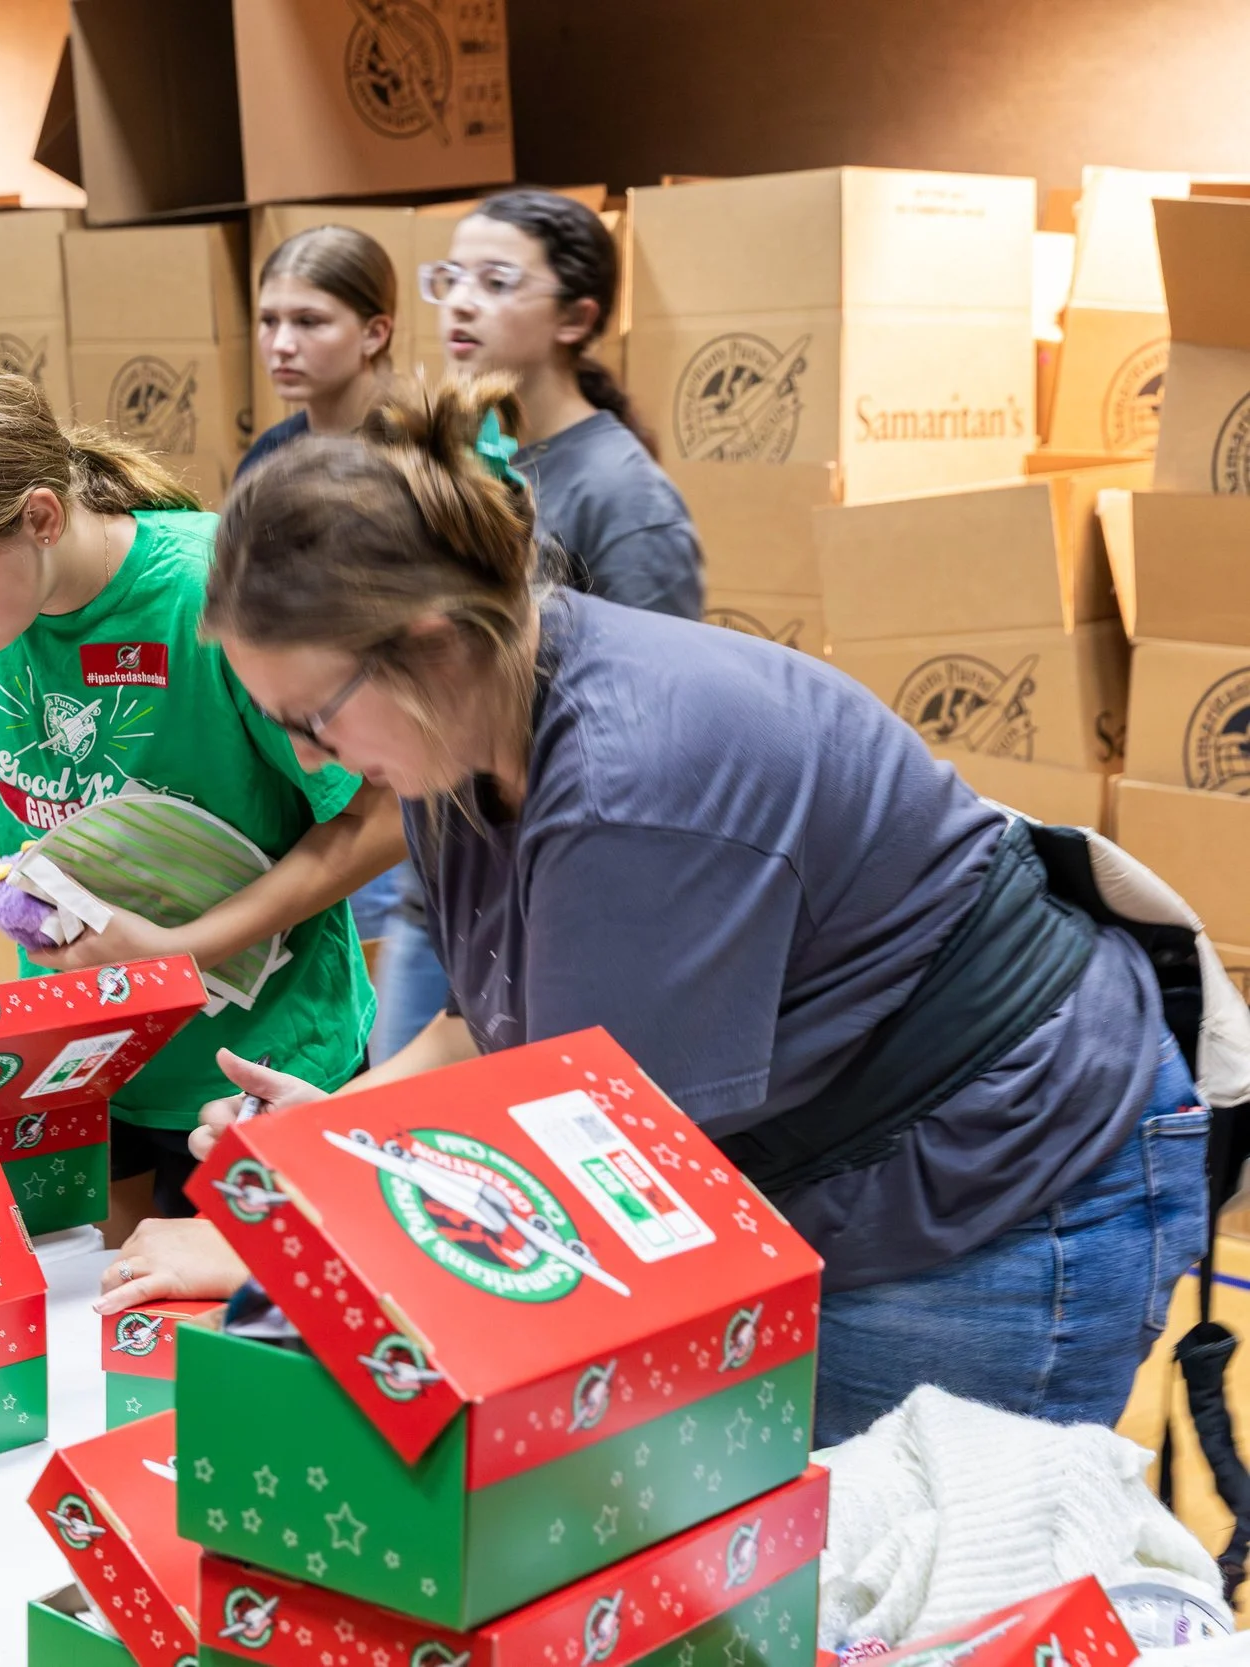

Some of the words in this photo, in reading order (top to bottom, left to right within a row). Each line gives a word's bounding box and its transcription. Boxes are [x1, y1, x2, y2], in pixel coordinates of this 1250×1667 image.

[855, 391, 1026, 443] Samaritan's
[86, 671, 167, 686] #ipackedashoebox
[54, 696, 79, 714] Purse
